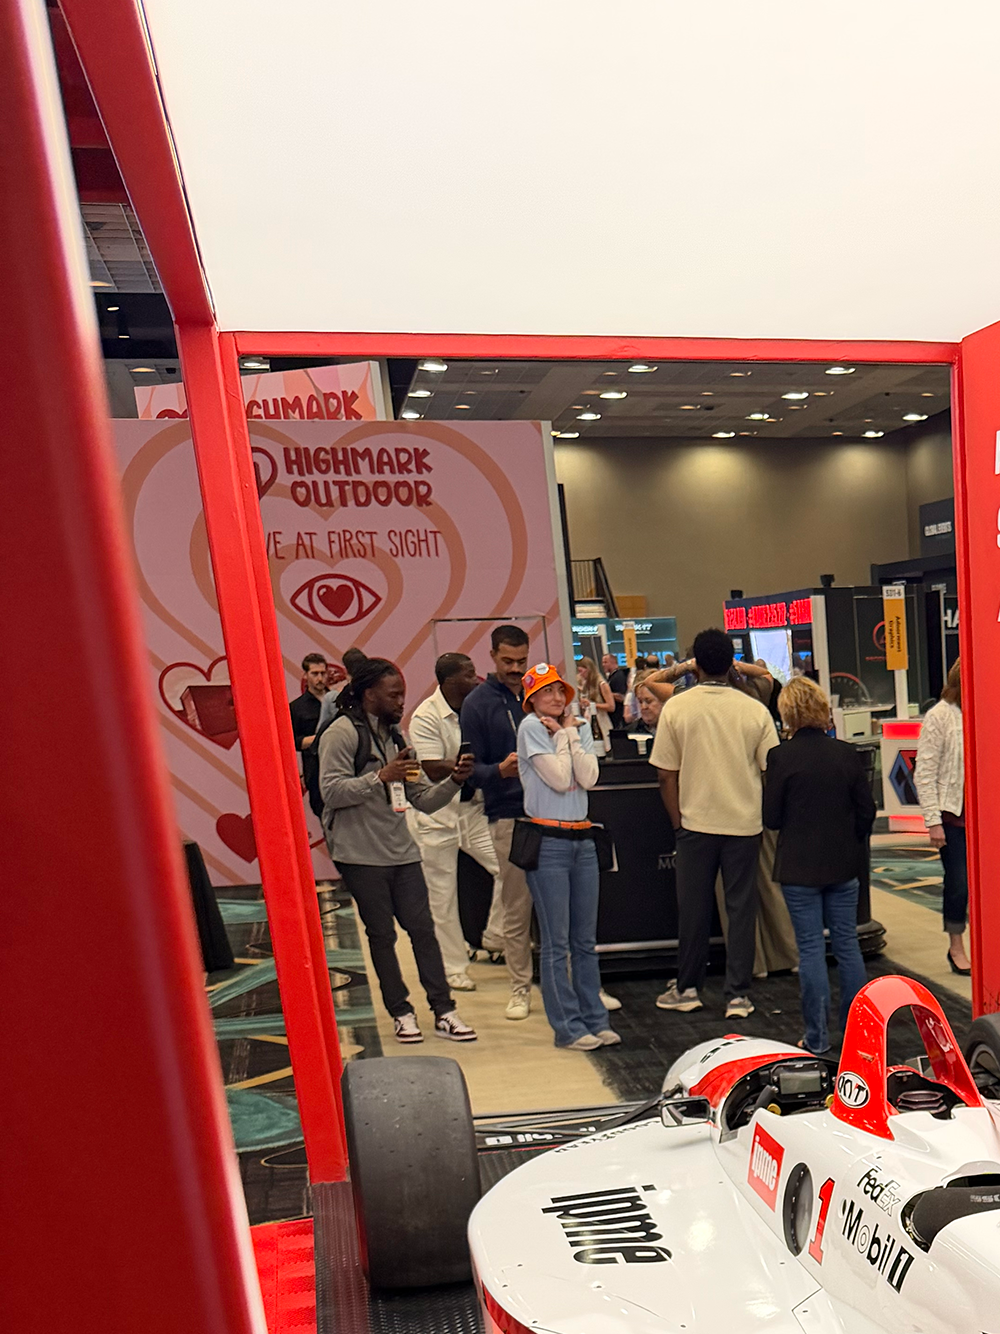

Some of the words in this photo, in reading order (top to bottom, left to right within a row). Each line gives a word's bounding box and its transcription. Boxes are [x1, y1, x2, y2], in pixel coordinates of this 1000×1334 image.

[246, 390, 363, 420] GHMARK
[283, 446, 433, 477] HIGHMARK
[290, 480, 433, 507] OUTDOOR
[295, 531, 318, 559] AT
[328, 529, 378, 559] FIRST
[387, 529, 442, 559] SIGHT
[808, 1177, 835, 1266] 1
[841, 1198, 896, 1276] Mobil
